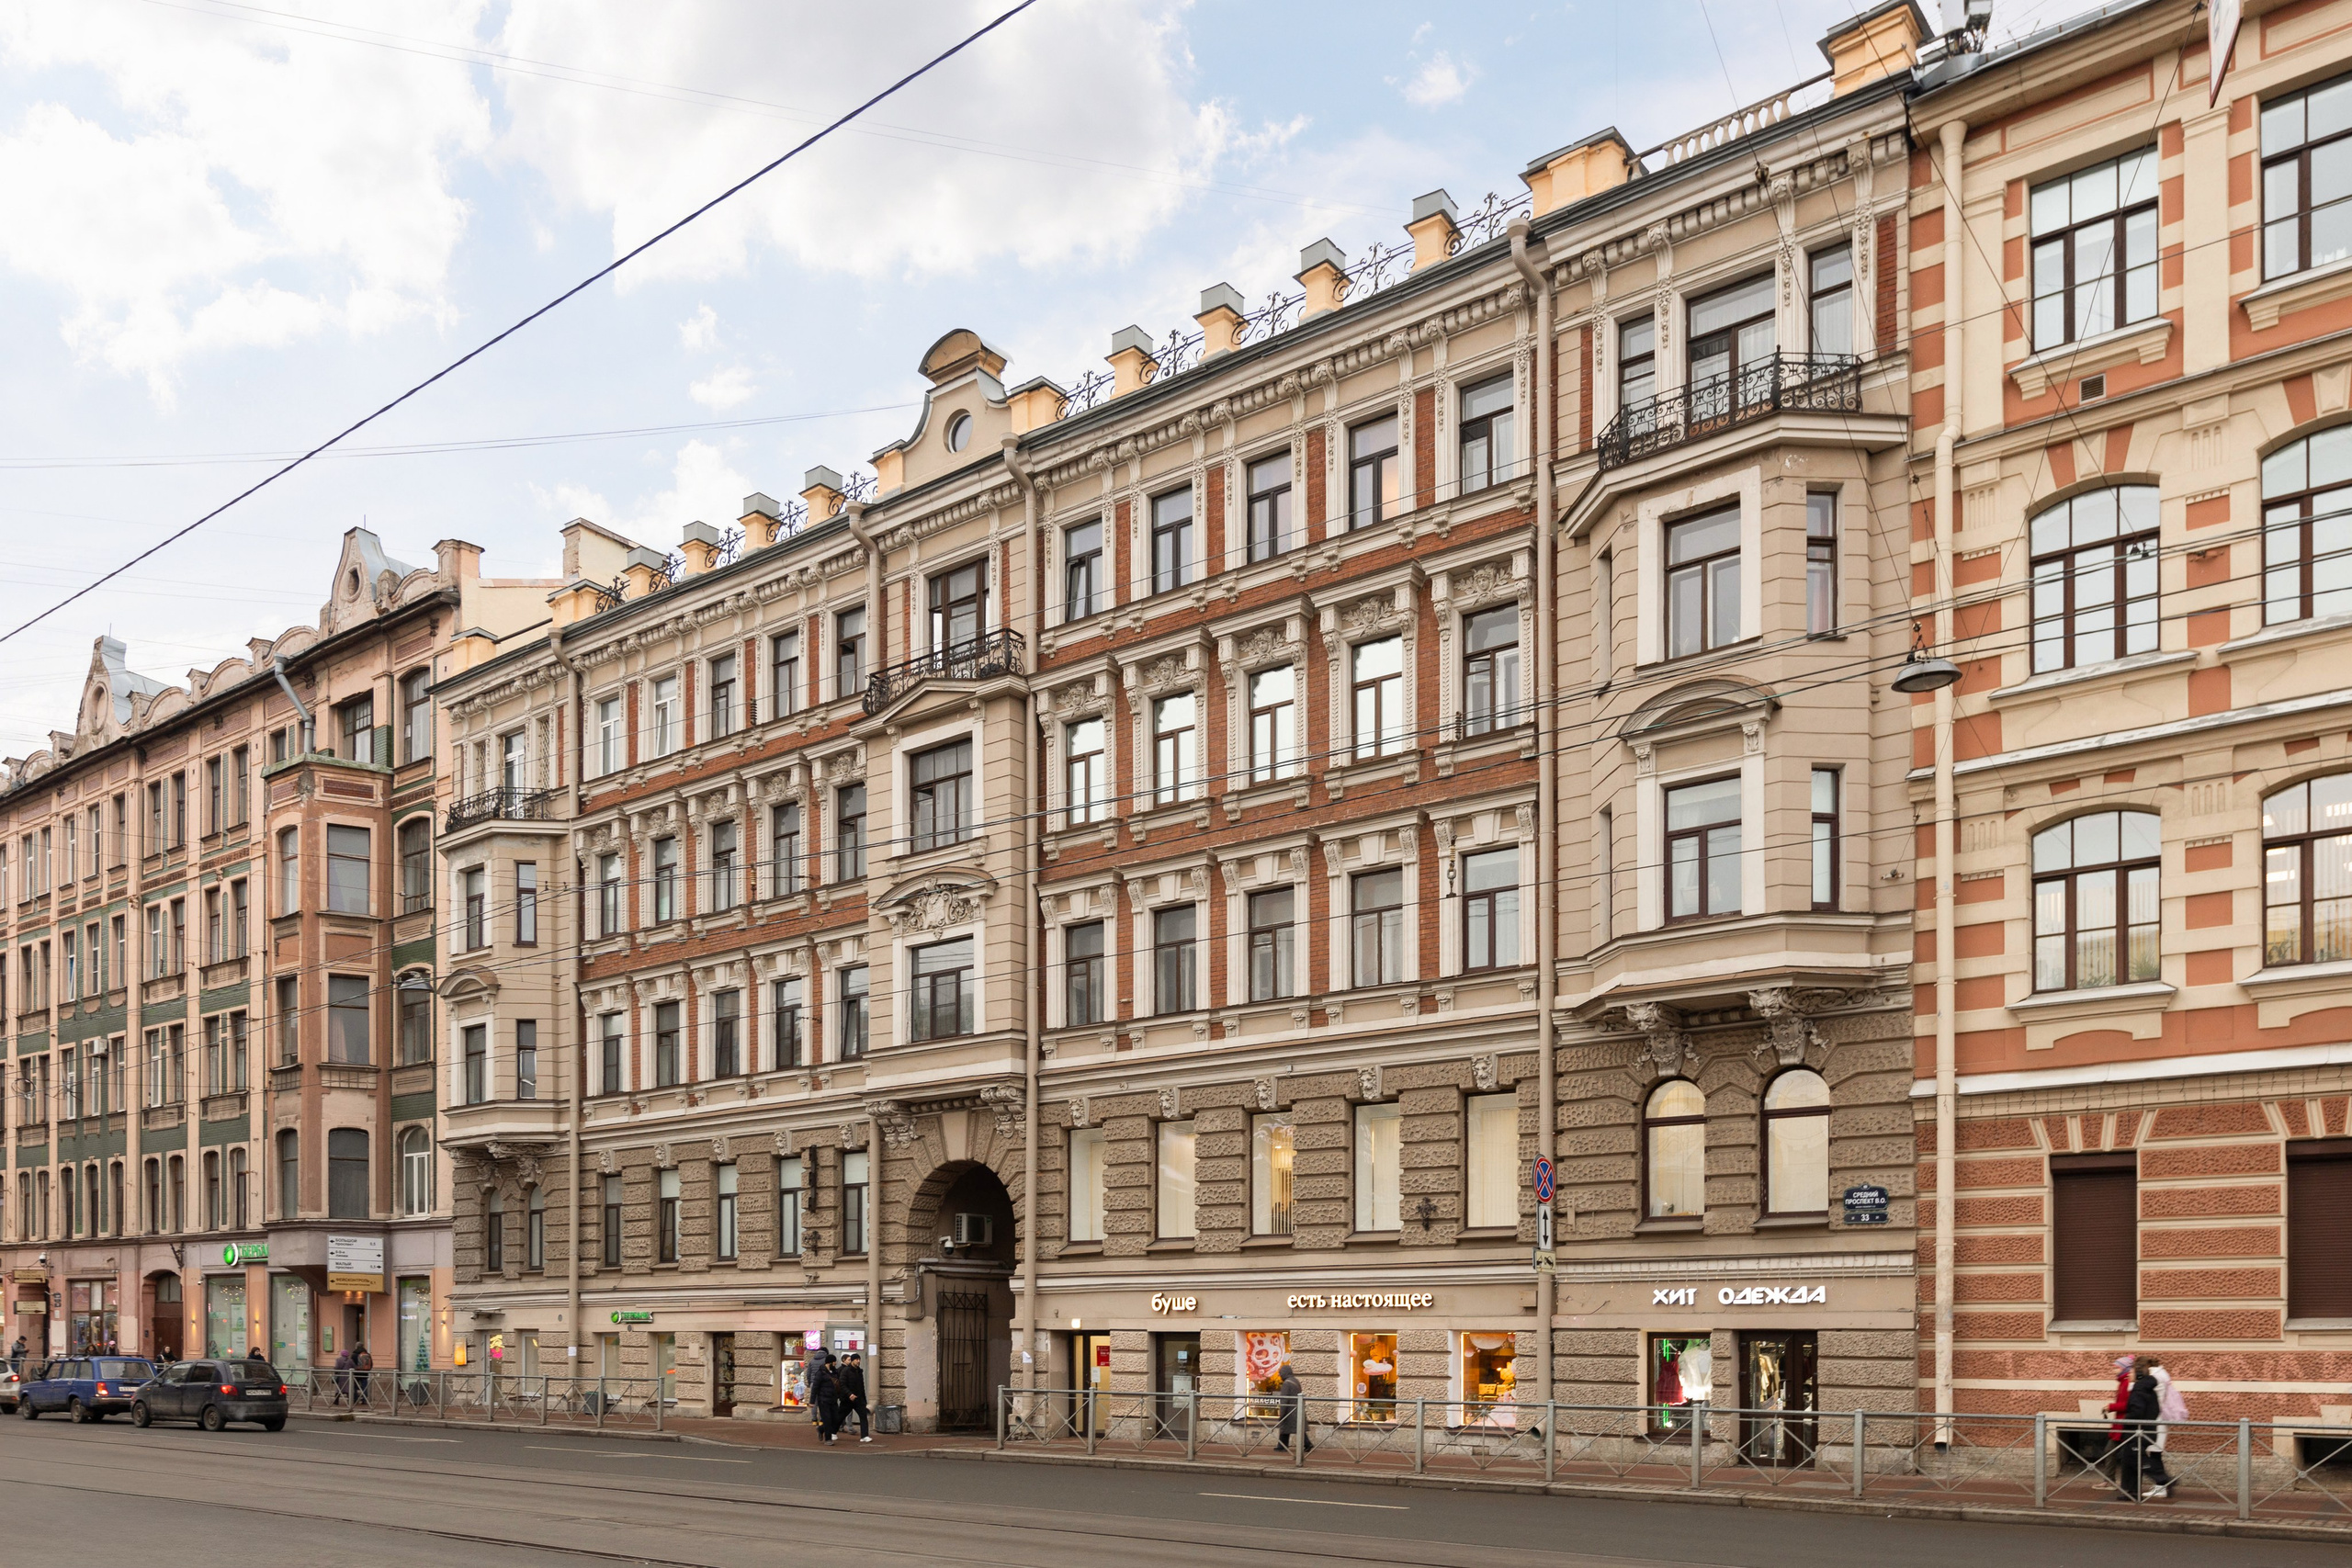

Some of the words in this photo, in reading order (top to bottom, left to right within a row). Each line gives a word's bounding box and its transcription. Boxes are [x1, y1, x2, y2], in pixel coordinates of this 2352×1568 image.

[1860, 1213, 1870, 1222] 33
[1151, 1292, 1197, 1314] буше
[1287, 1294, 1327, 1308] есть
[1330, 1292, 1433, 1311] настоящее
[1652, 1288, 1698, 1305] ХИТ
[1718, 1286, 1826, 1305] ОДЕЖДА
